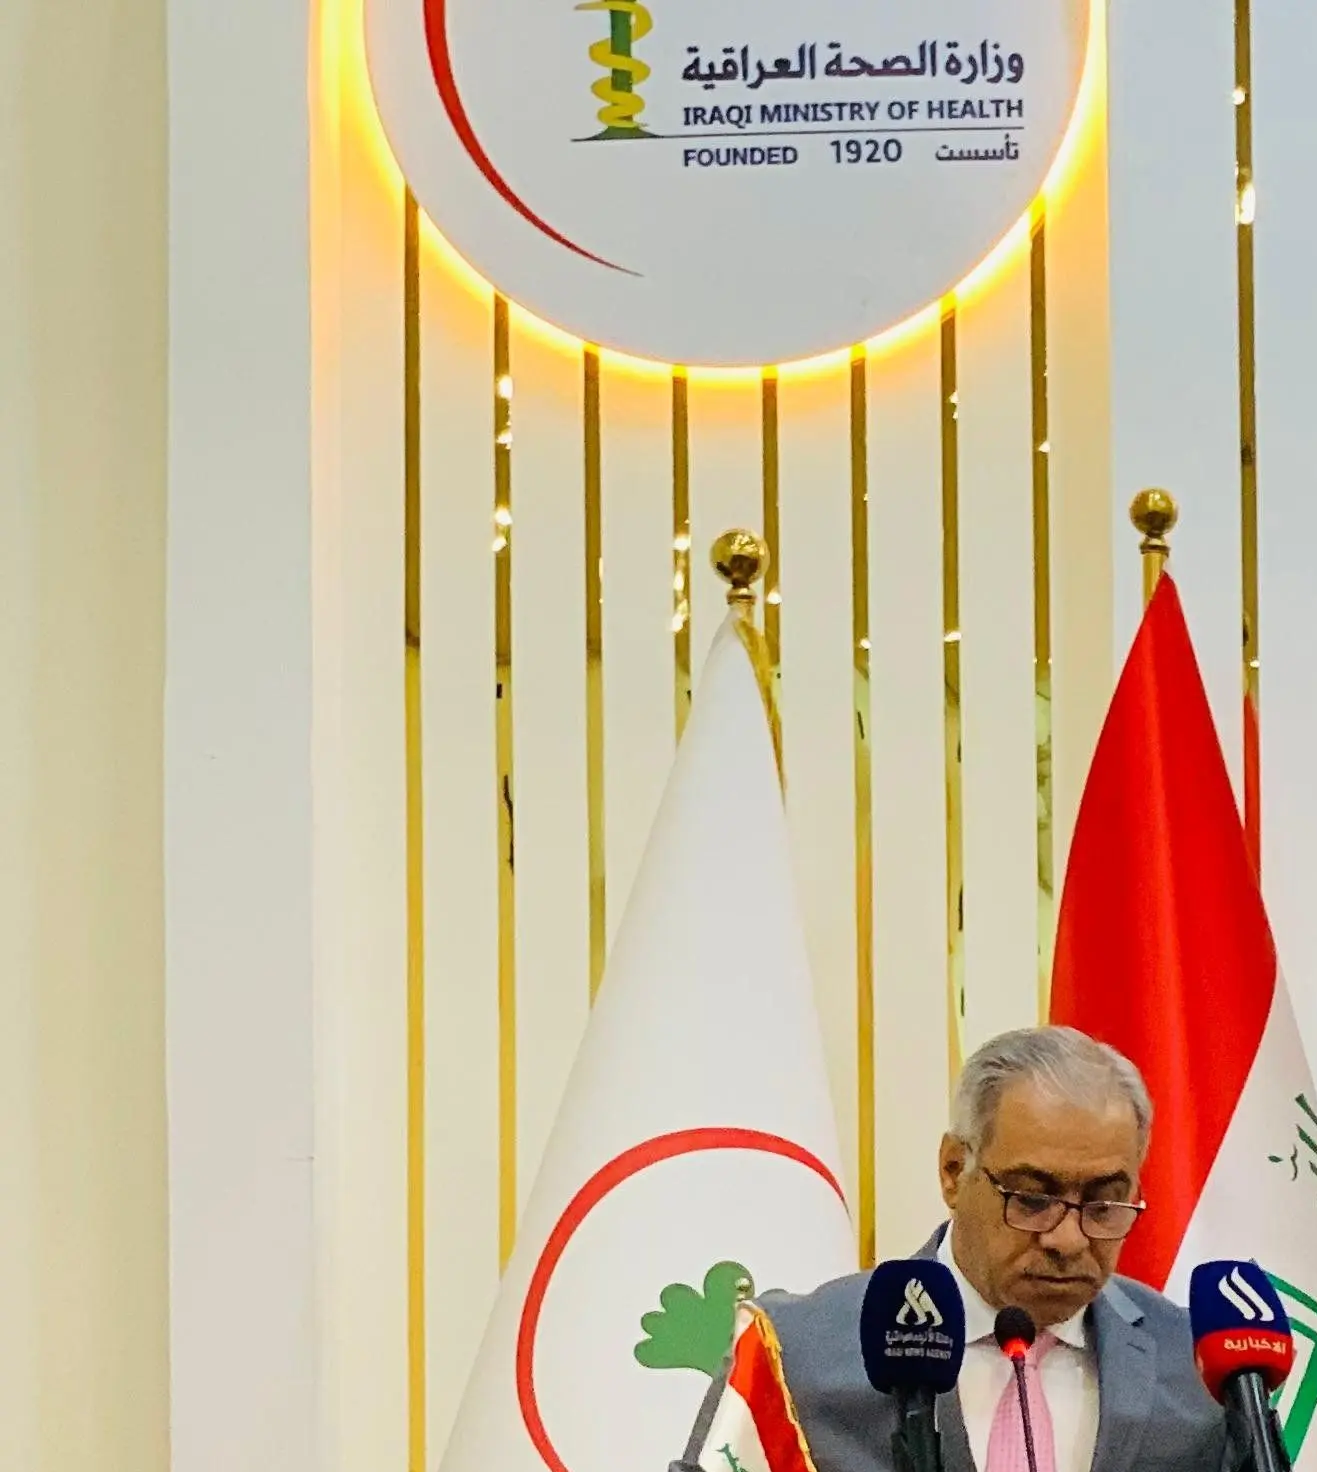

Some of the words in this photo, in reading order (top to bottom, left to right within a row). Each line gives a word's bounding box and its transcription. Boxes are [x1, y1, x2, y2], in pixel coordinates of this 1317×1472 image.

[682, 43, 816, 90] العراقية
[824, 40, 937, 77] الصحة
[945, 39, 1024, 84] وزارة
[684, 104, 752, 129] IRAQI
[760, 101, 879, 123] MINISTRY
[888, 101, 919, 120] OF
[927, 99, 1023, 119] HEALTH
[684, 146, 798, 167] FOUNDED
[830, 139, 902, 163] 1920
[935, 134, 1020, 161] تأسست
